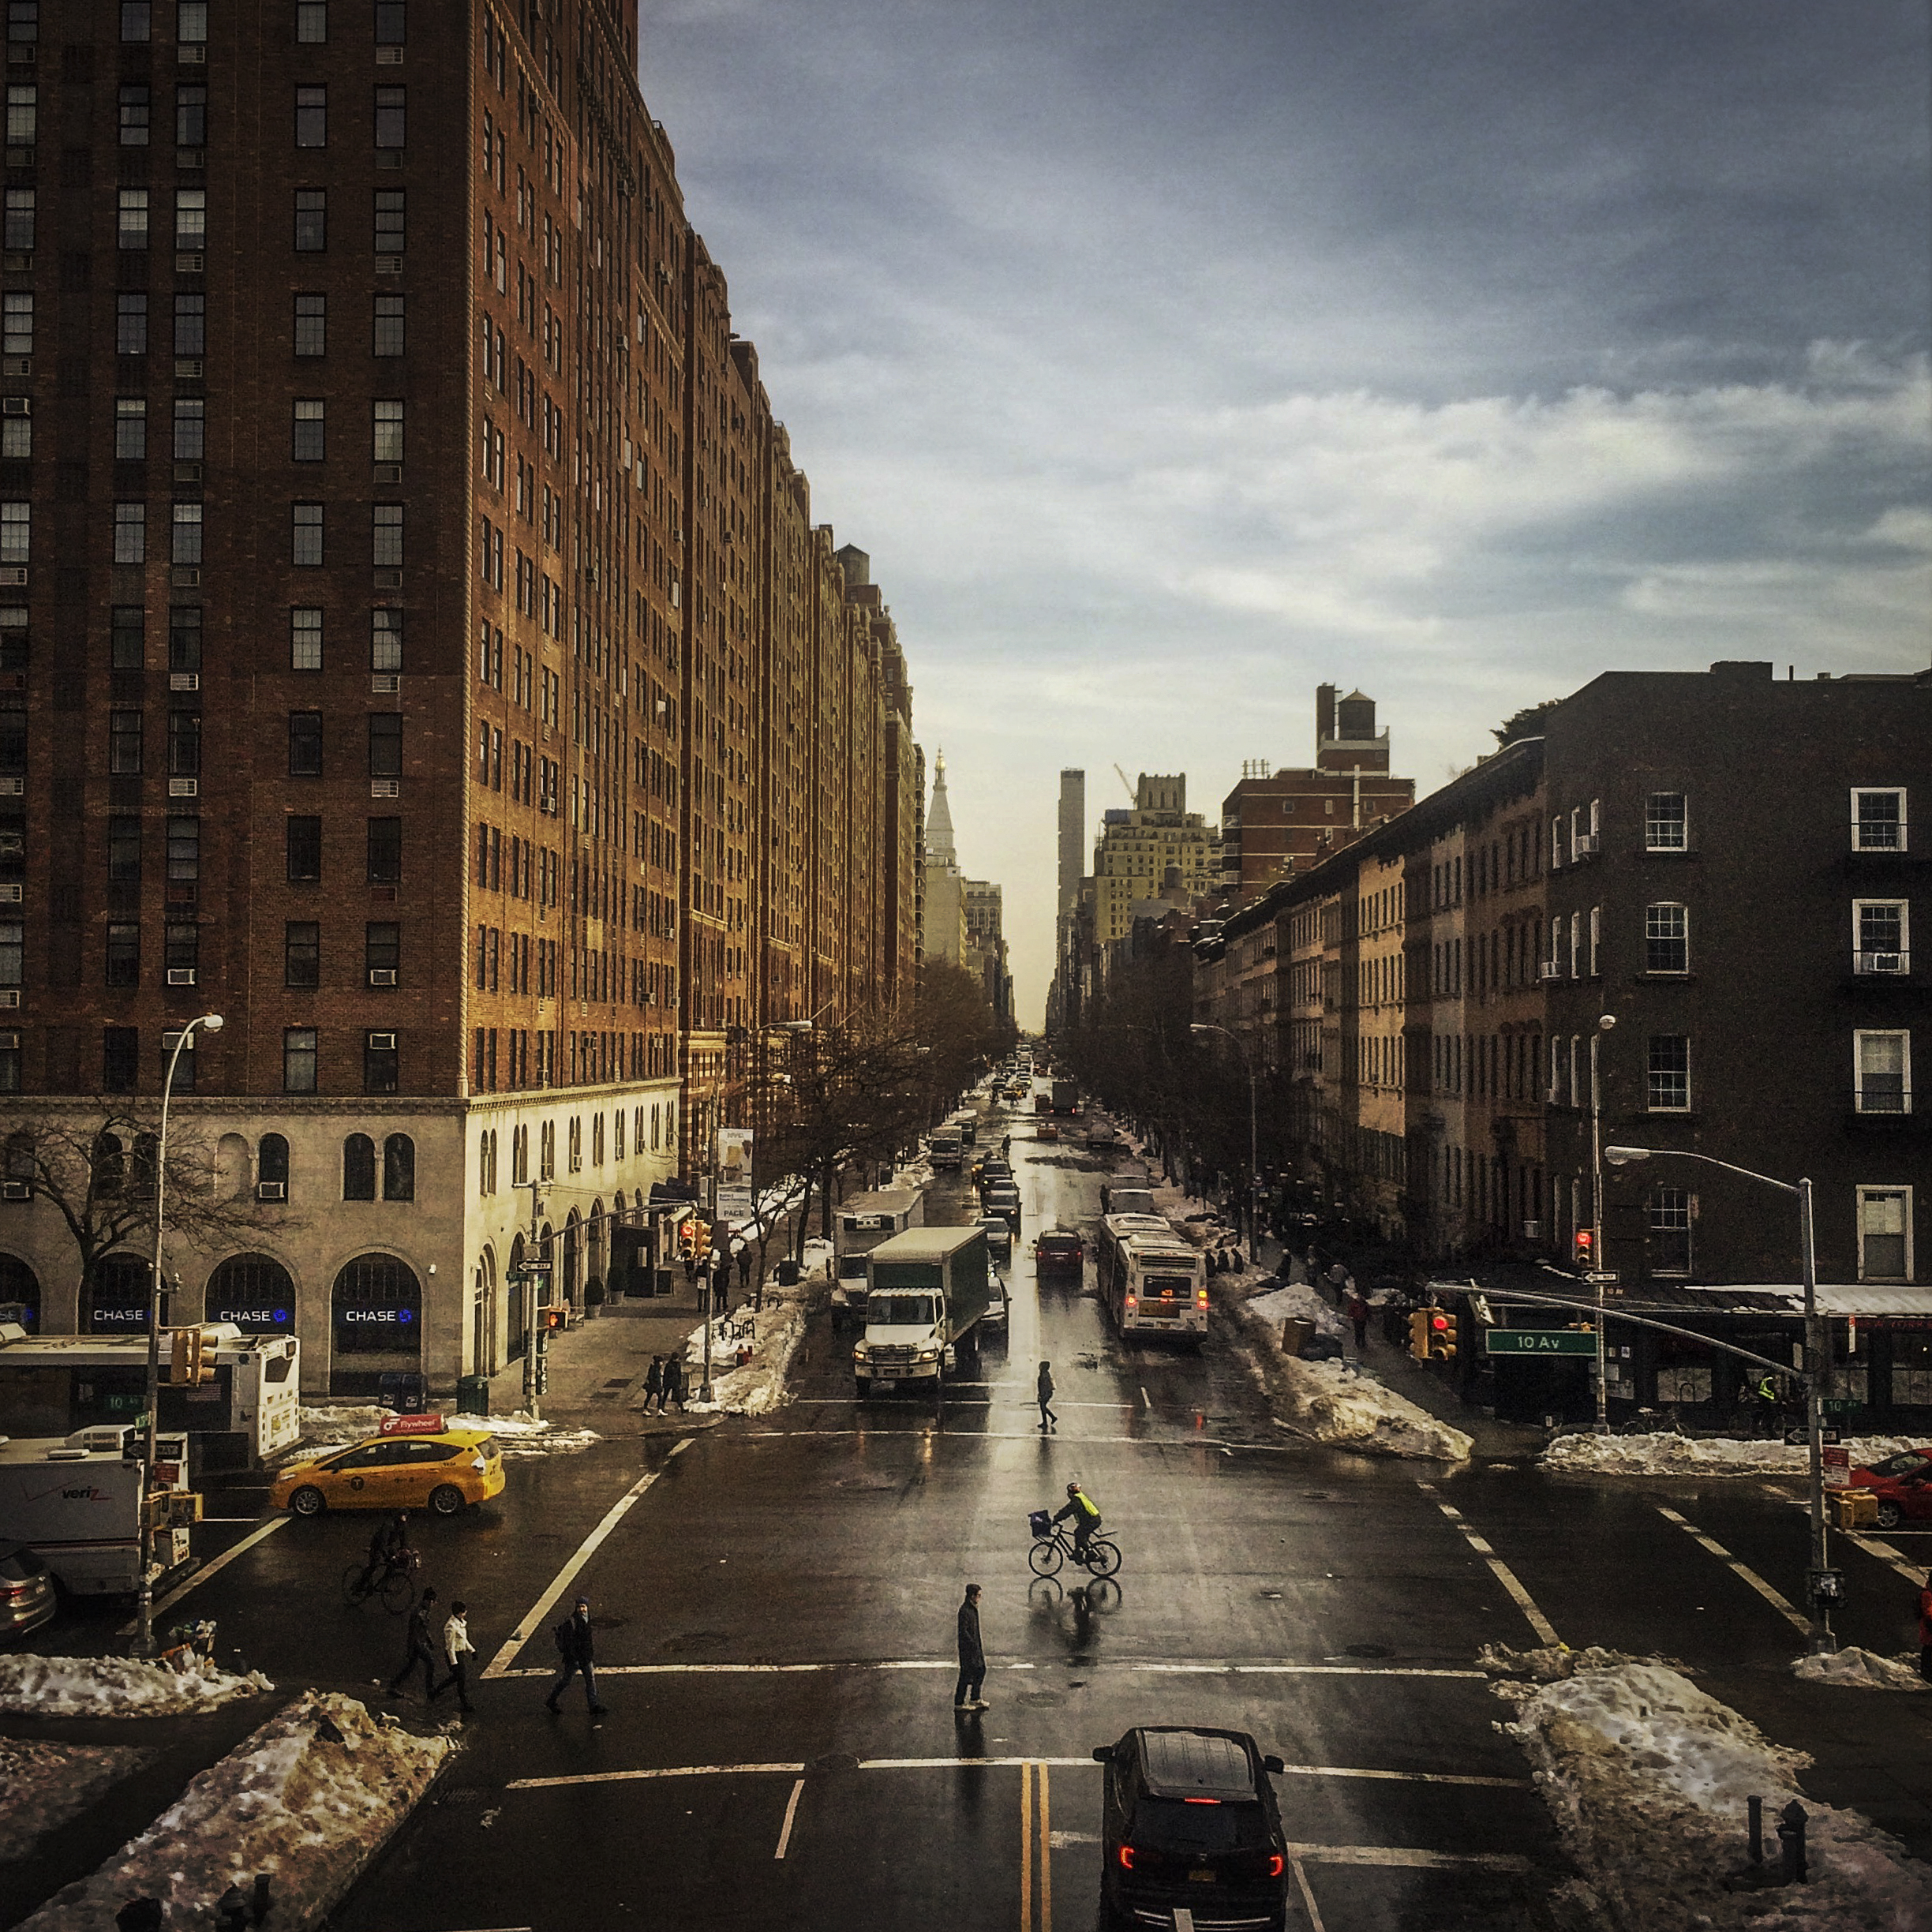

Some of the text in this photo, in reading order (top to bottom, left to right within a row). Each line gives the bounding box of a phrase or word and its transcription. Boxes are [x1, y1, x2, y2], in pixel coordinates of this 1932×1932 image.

[93, 1309, 144, 1320] CHASE
[220, 1310, 271, 1321] CHASE
[346, 1310, 396, 1321] CHASE
[1518, 1336, 1559, 1349] 10 Av
[1829, 1401, 1841, 1411] 10
